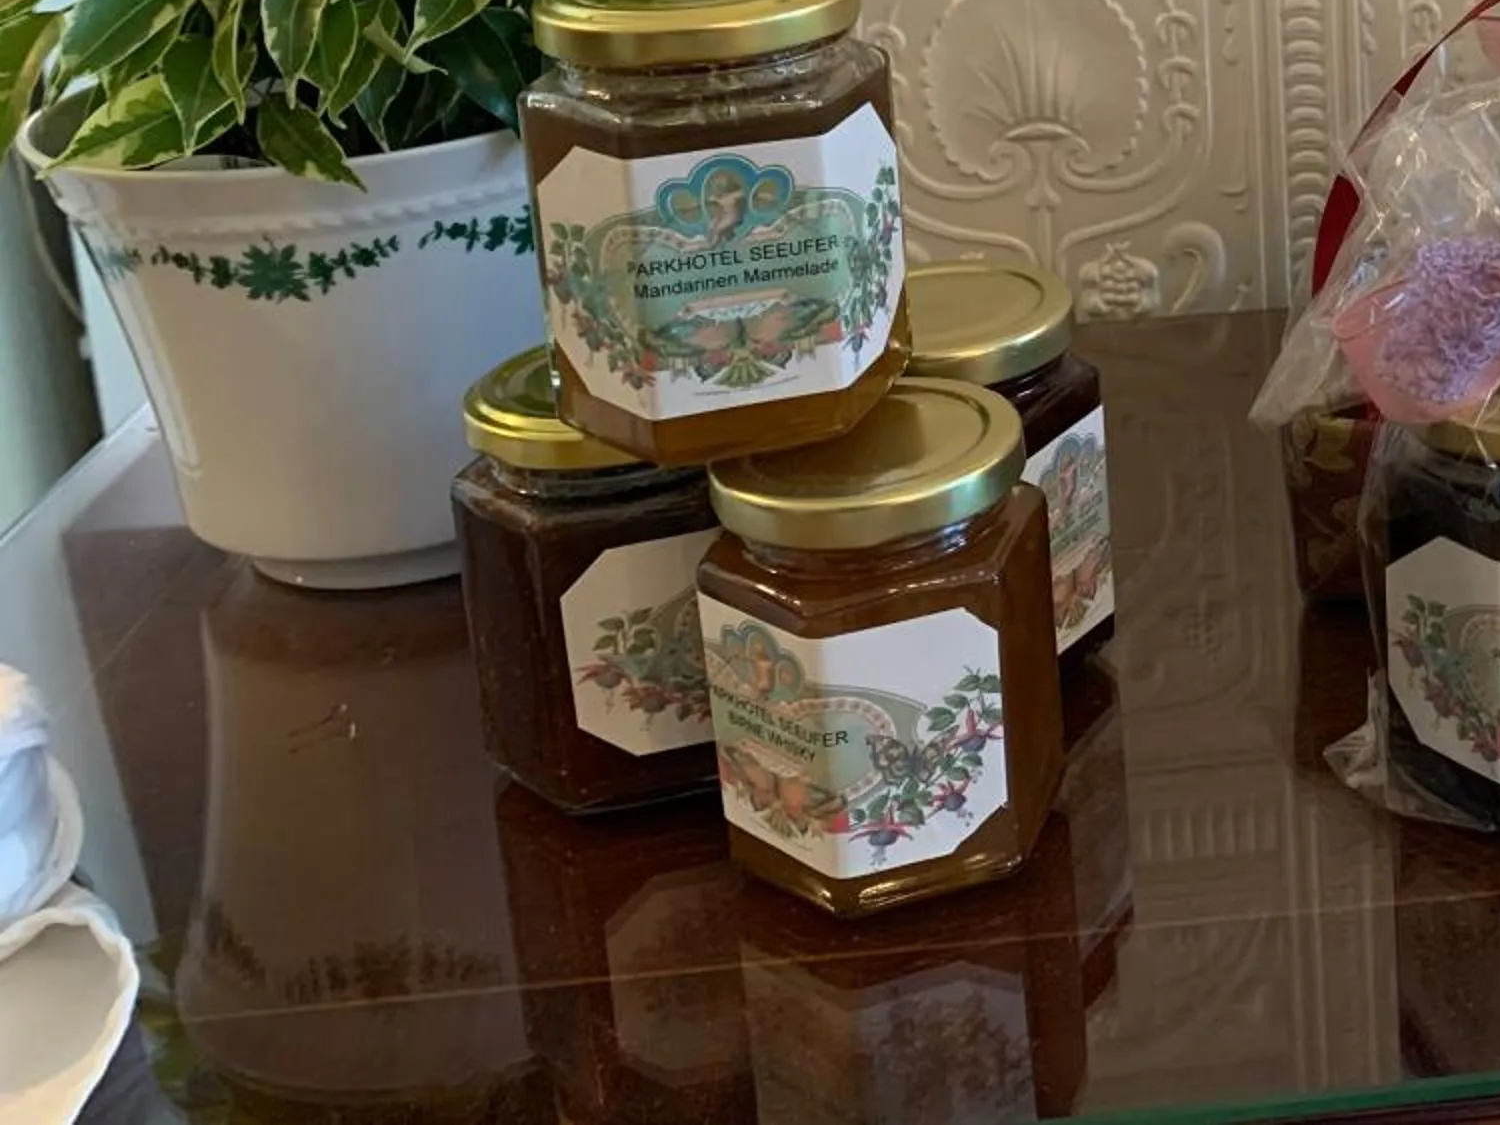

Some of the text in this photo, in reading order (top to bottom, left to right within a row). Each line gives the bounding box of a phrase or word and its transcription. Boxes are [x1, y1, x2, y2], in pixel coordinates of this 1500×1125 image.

[627, 235, 839, 277] PARKHOTEL SEEUFER
[743, 257, 839, 284] Marmelade
